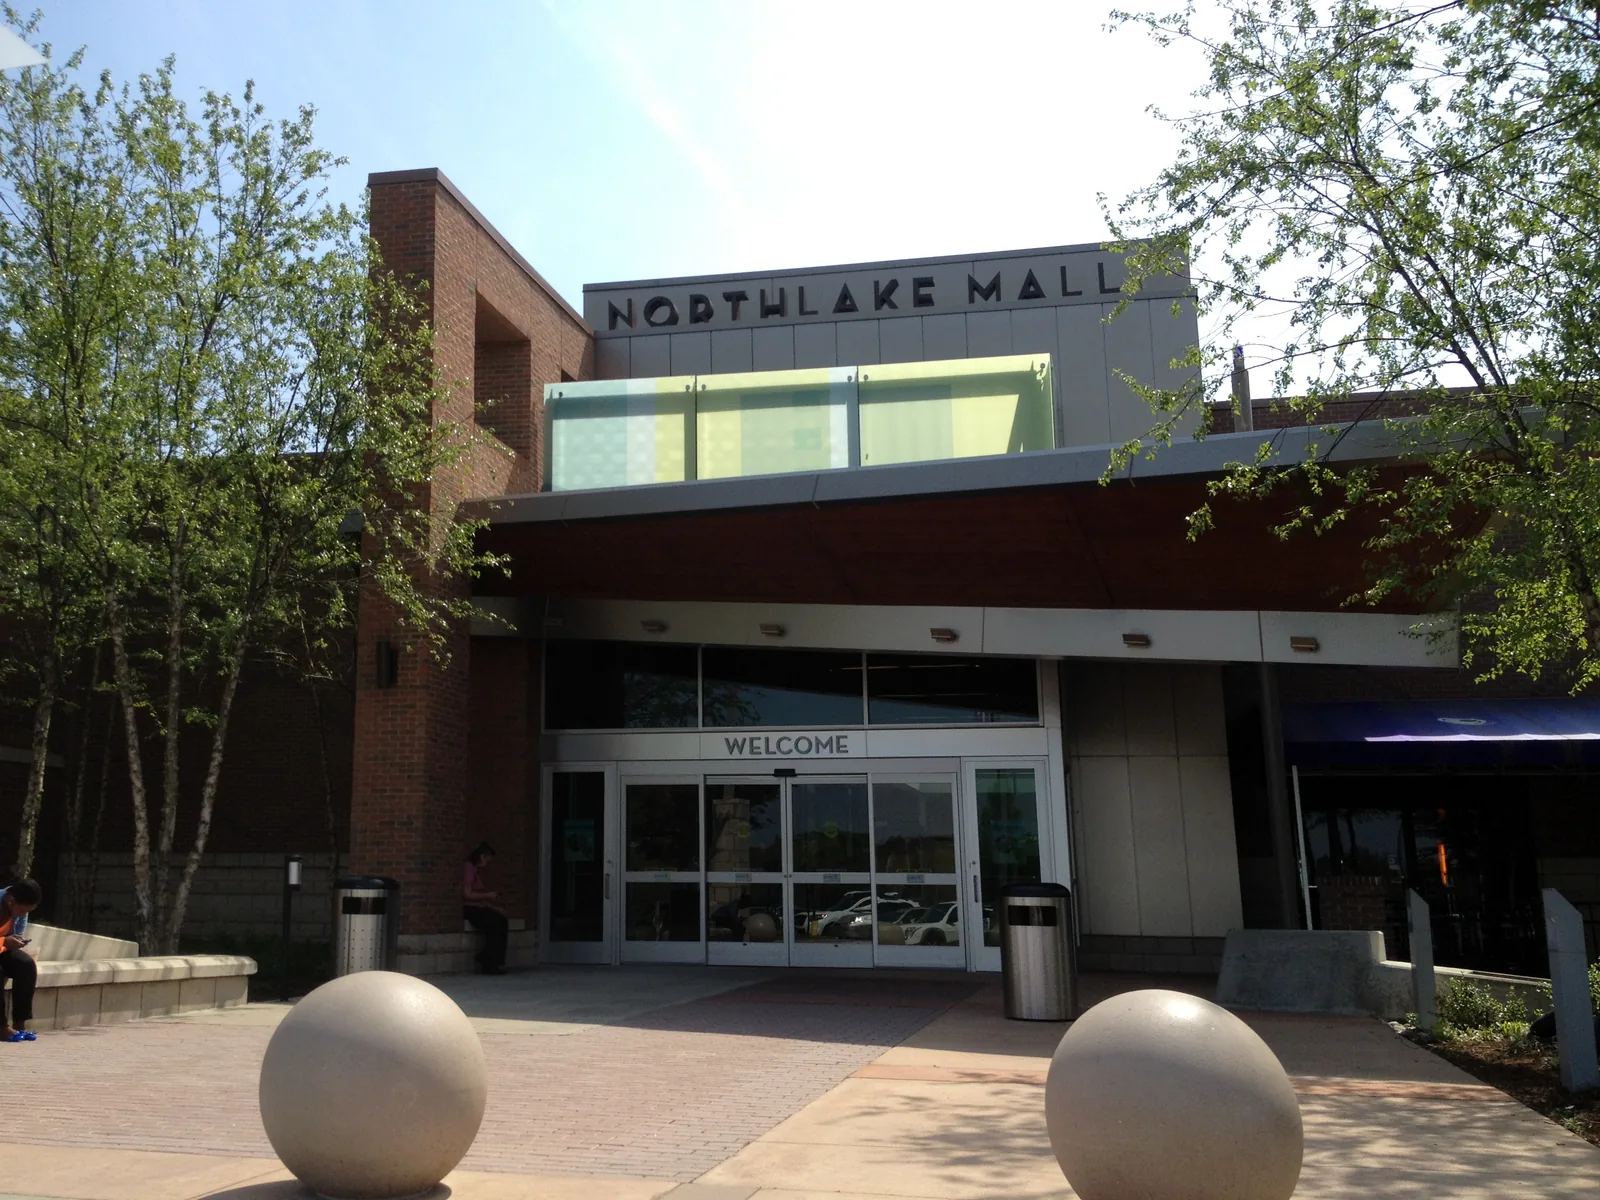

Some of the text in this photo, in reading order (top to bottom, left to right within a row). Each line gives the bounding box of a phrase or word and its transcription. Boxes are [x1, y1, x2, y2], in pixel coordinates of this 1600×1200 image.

[608, 262, 1122, 331] NORTHLAKE MALL
[724, 735, 849, 756] WELCOME
